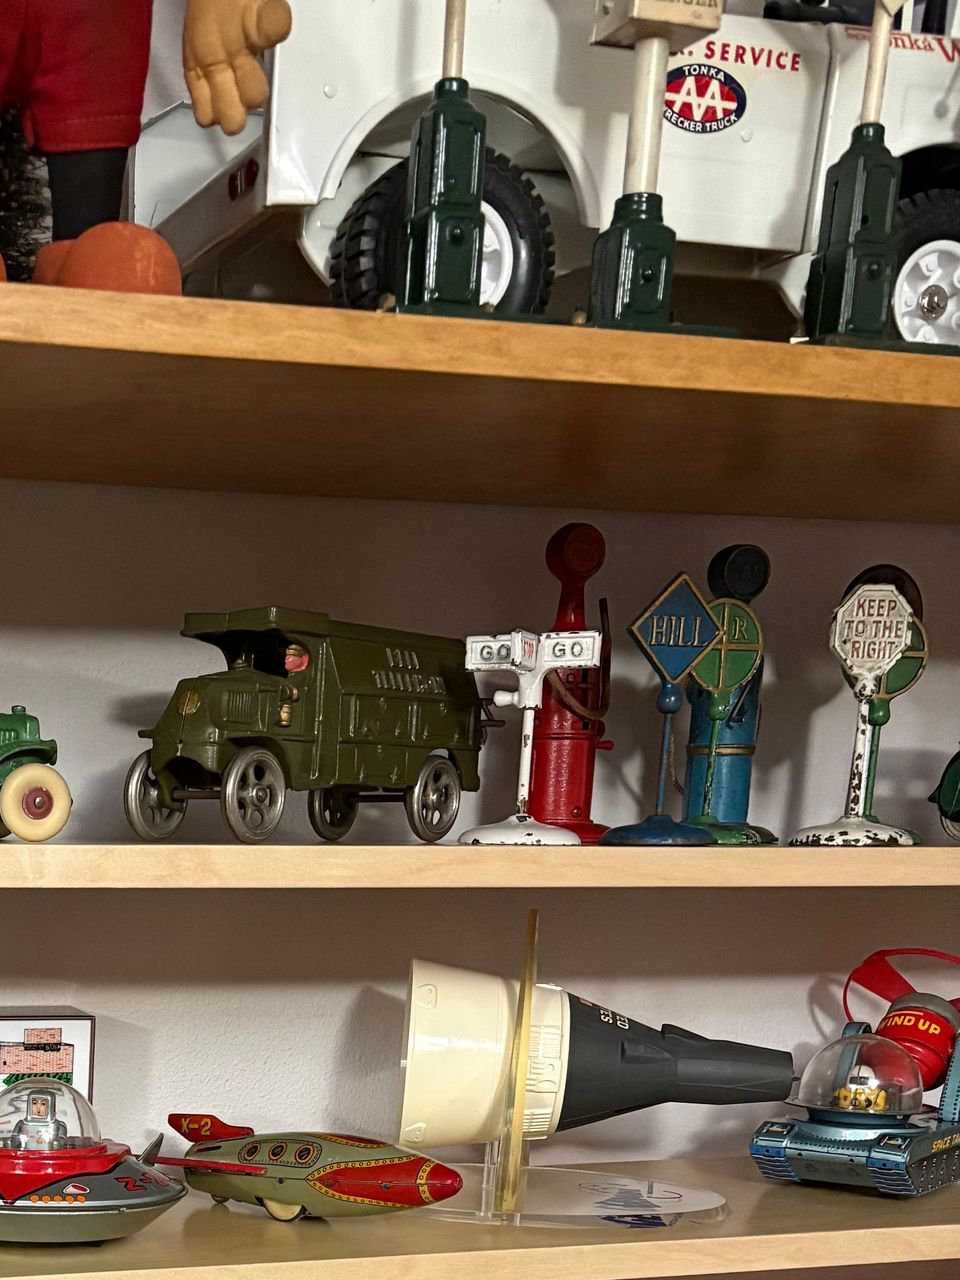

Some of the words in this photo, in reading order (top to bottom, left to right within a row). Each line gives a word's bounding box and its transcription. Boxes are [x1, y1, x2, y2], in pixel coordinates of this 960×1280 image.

[704, 40, 801, 72] SERVICE
[683, 65, 725, 83] TONKA
[664, 108, 703, 132] RECKER
[705, 113, 738, 132] TRUCK
[855, 599, 897, 617] KEEP
[649, 615, 709, 646] HILL
[844, 620, 866, 637] TO
[872, 620, 904, 638] THE
[480, 644, 512, 661] GO
[552, 641, 584, 658] GO
[851, 641, 895, 659] RIGHT
[917, 1019, 941, 1035] UP
[181, 1117, 212, 1136] X-2
